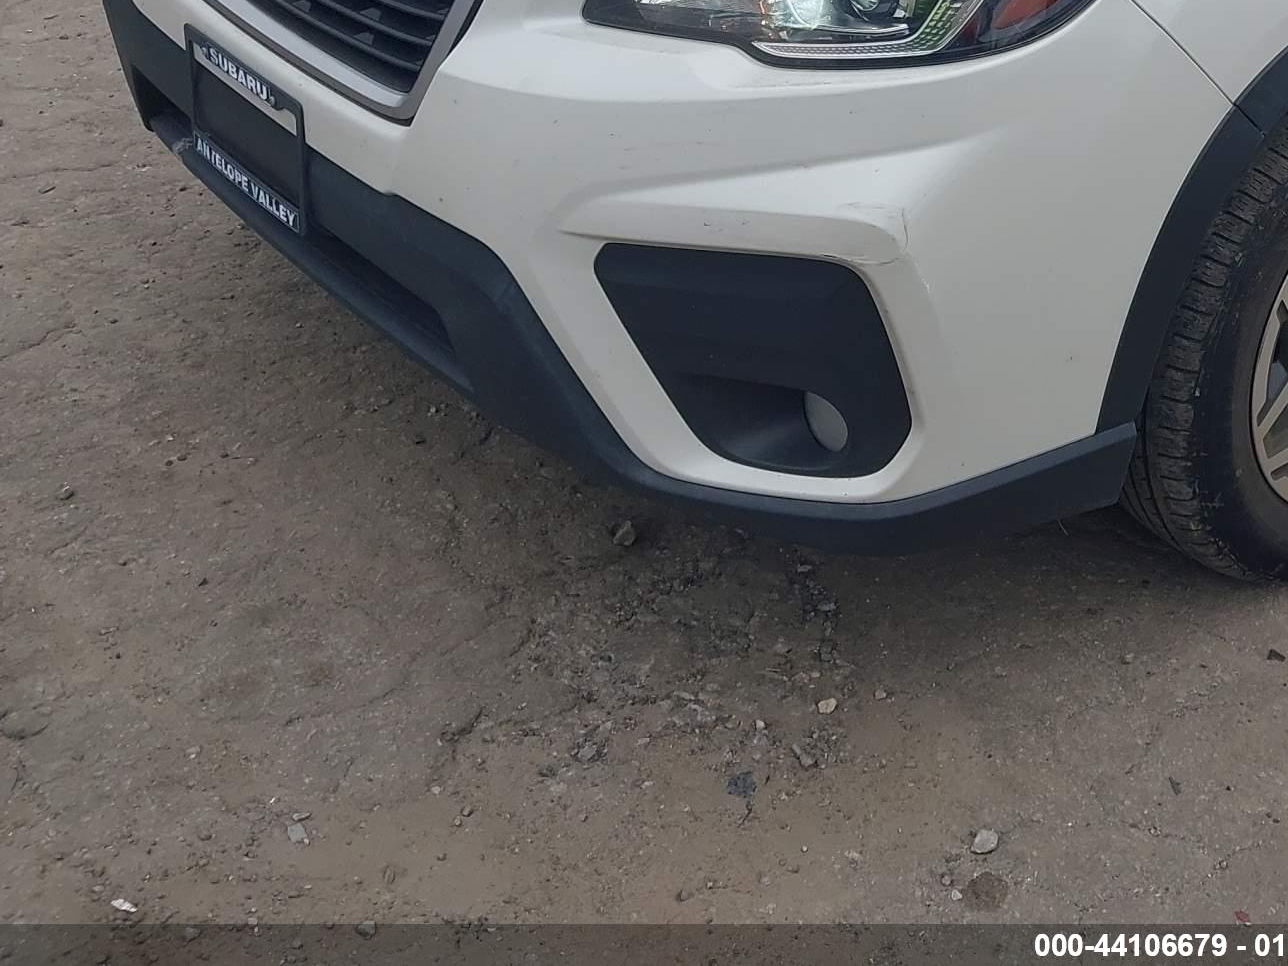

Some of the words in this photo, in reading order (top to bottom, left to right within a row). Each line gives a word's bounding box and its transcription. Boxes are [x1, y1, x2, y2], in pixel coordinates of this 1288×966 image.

[209, 47, 268, 101] SUBARU
[197, 137, 249, 192] ANTELOPE
[250, 182, 295, 227] VALLEY
